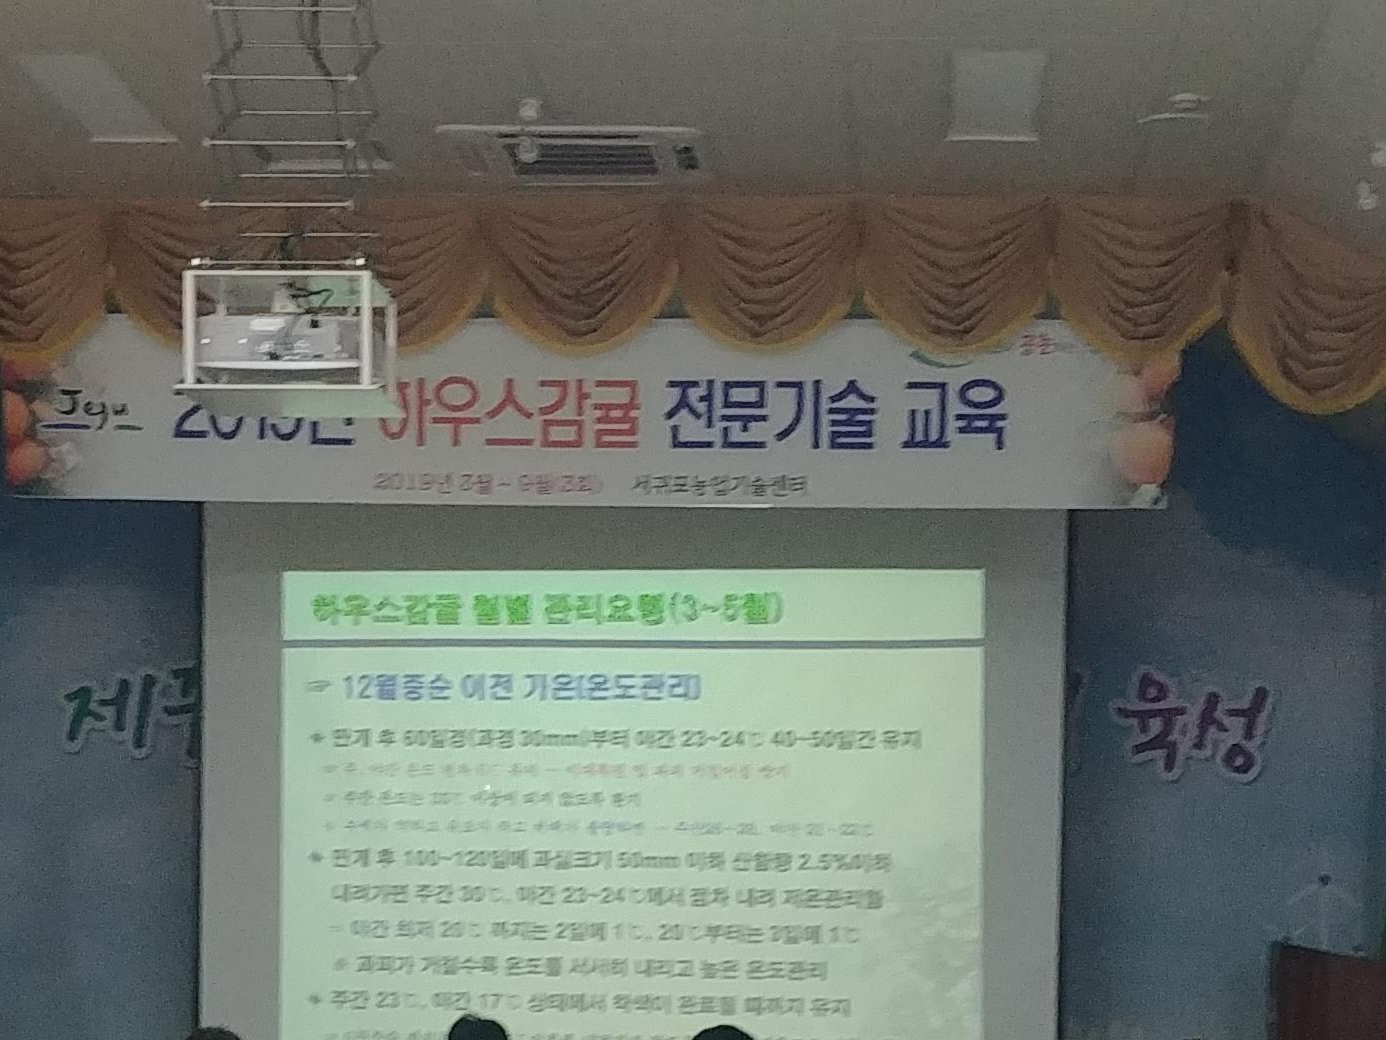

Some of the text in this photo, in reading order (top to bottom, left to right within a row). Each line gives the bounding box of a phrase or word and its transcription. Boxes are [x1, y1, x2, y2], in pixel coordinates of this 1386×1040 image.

[379, 376, 640, 449] 하우스감귤
[664, 377, 879, 451] 전문기술
[901, 377, 1008, 452] 교육
[310, 591, 462, 627] 하우스감귤
[460, 674, 514, 701] 이전
[1115, 670, 1270, 775] 육성
